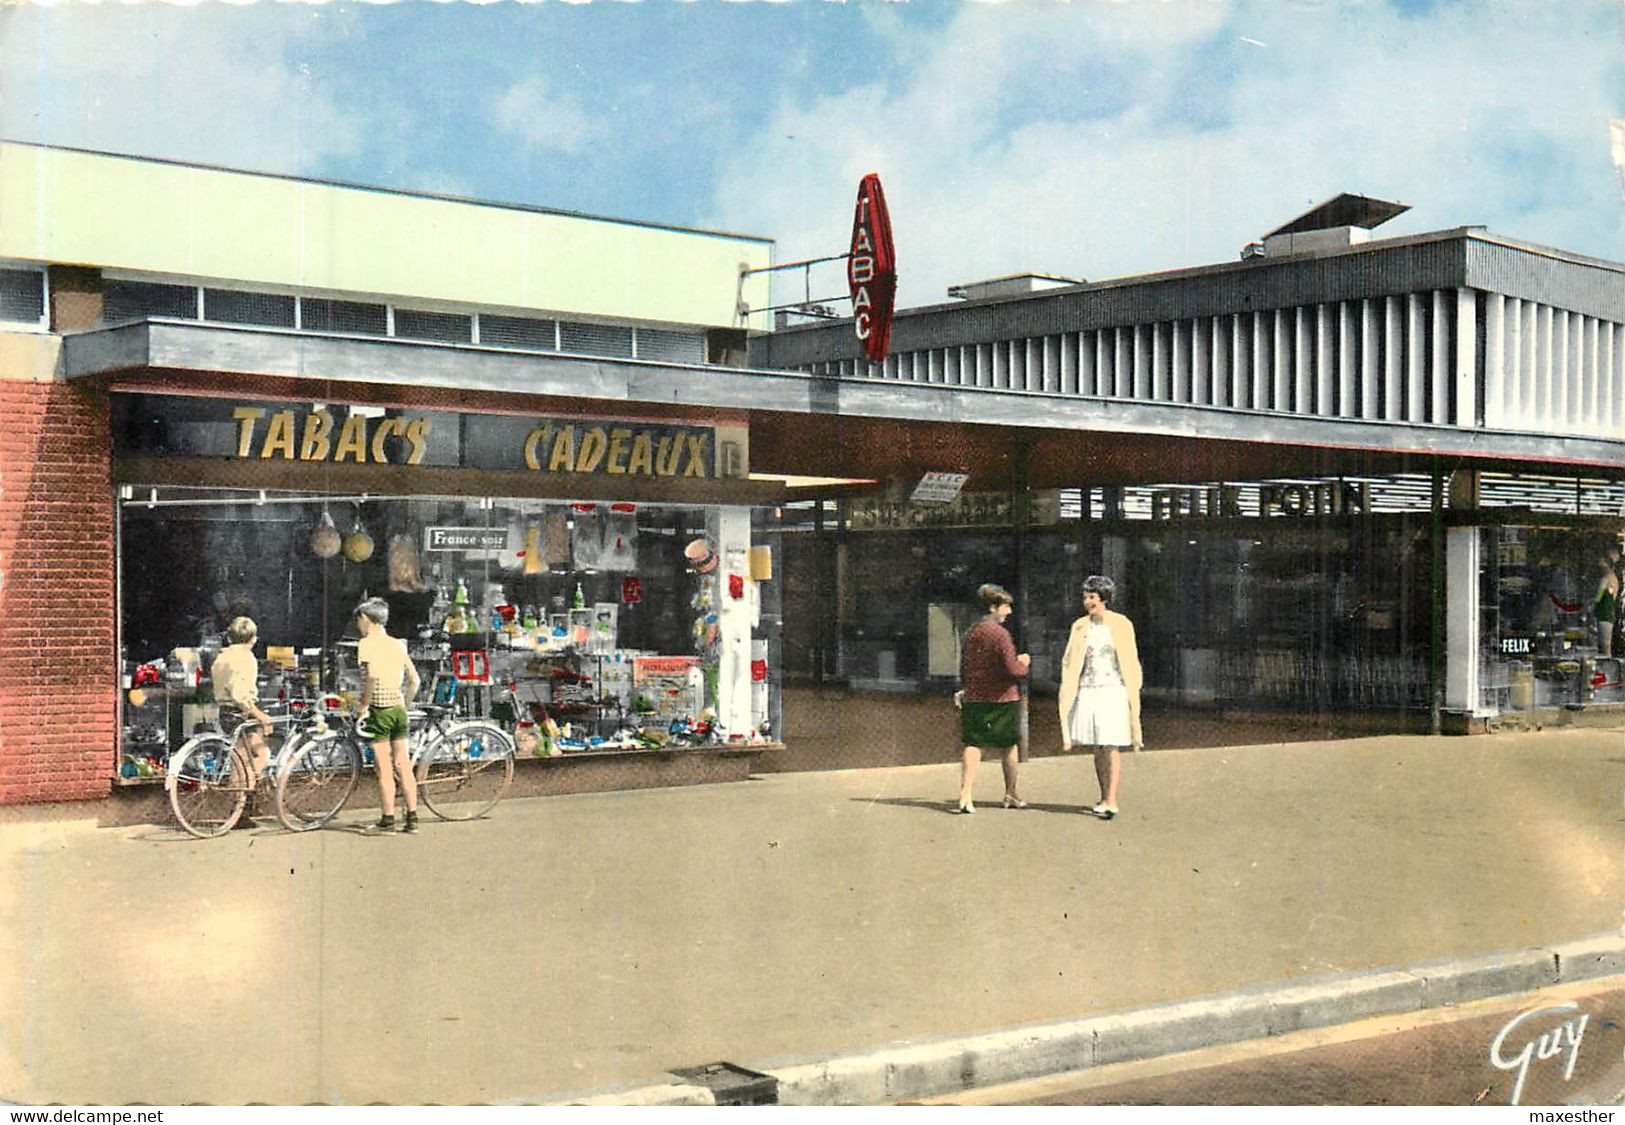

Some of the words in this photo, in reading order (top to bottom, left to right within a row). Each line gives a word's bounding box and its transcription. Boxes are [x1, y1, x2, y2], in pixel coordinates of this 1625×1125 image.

[853, 197, 874, 340] TABAC
[233, 406, 432, 465] TABACS
[524, 423, 706, 478] CADEAUX
